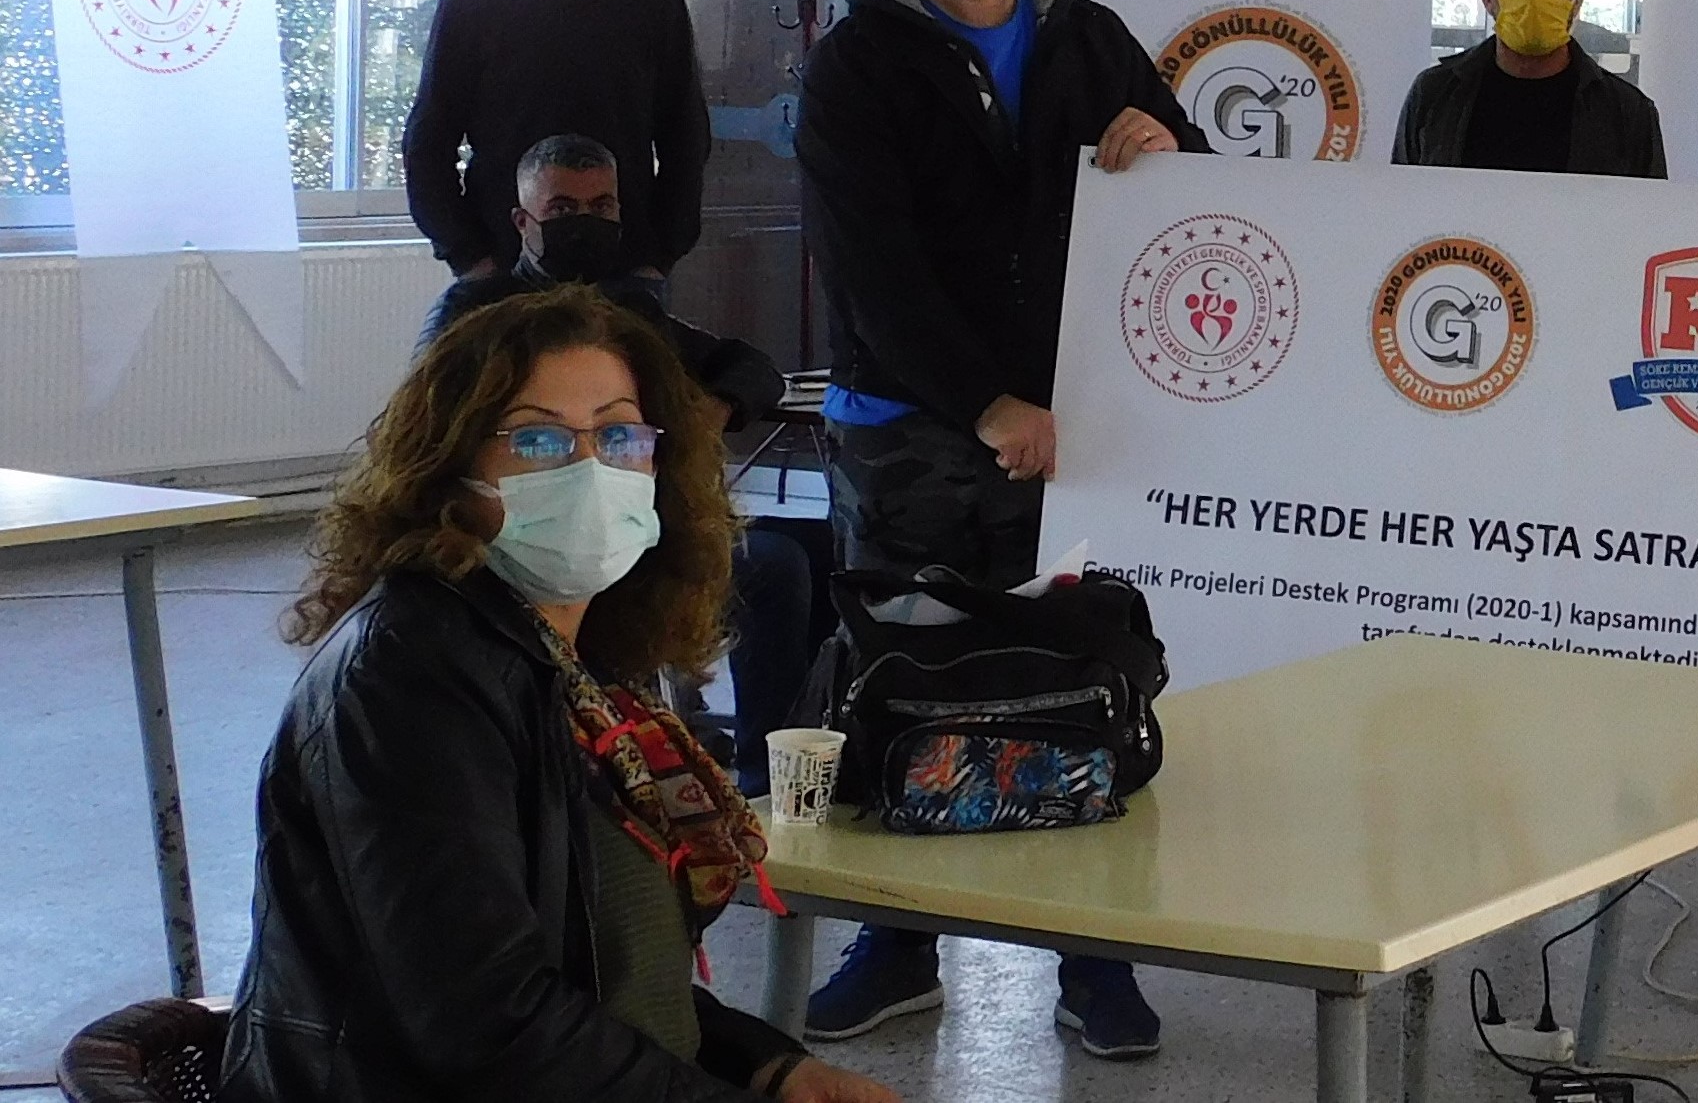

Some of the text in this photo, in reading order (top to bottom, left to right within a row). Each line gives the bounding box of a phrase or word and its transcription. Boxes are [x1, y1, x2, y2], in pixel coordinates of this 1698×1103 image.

[1179, 13, 1329, 67] GÖNÜLLÜLÜK
[1324, 64, 1350, 110] YILI
[1326, 123, 1351, 161] 202
[1246, 265, 1258, 278] VE
[1254, 281, 1267, 313] SPOR
[1380, 242, 1526, 324] 2020 GÖNÜLLÜLÜK YILI
[1379, 327, 1527, 408] 2020 GÖNÜLLÜLÜK YILI
[1640, 363, 1671, 376] SÖKE
[1641, 377, 1689, 391] GENÇLİK
[1250, 499, 1368, 540] YERDE
[1380, 510, 1455, 549] HER
[1468, 517, 1582, 562] YAŞTA
[1170, 568, 1265, 596] Projeleri
[1272, 577, 1349, 604] Destek
[1356, 585, 1459, 613] Programı
[1466, 593, 1563, 627] (2020-1)
